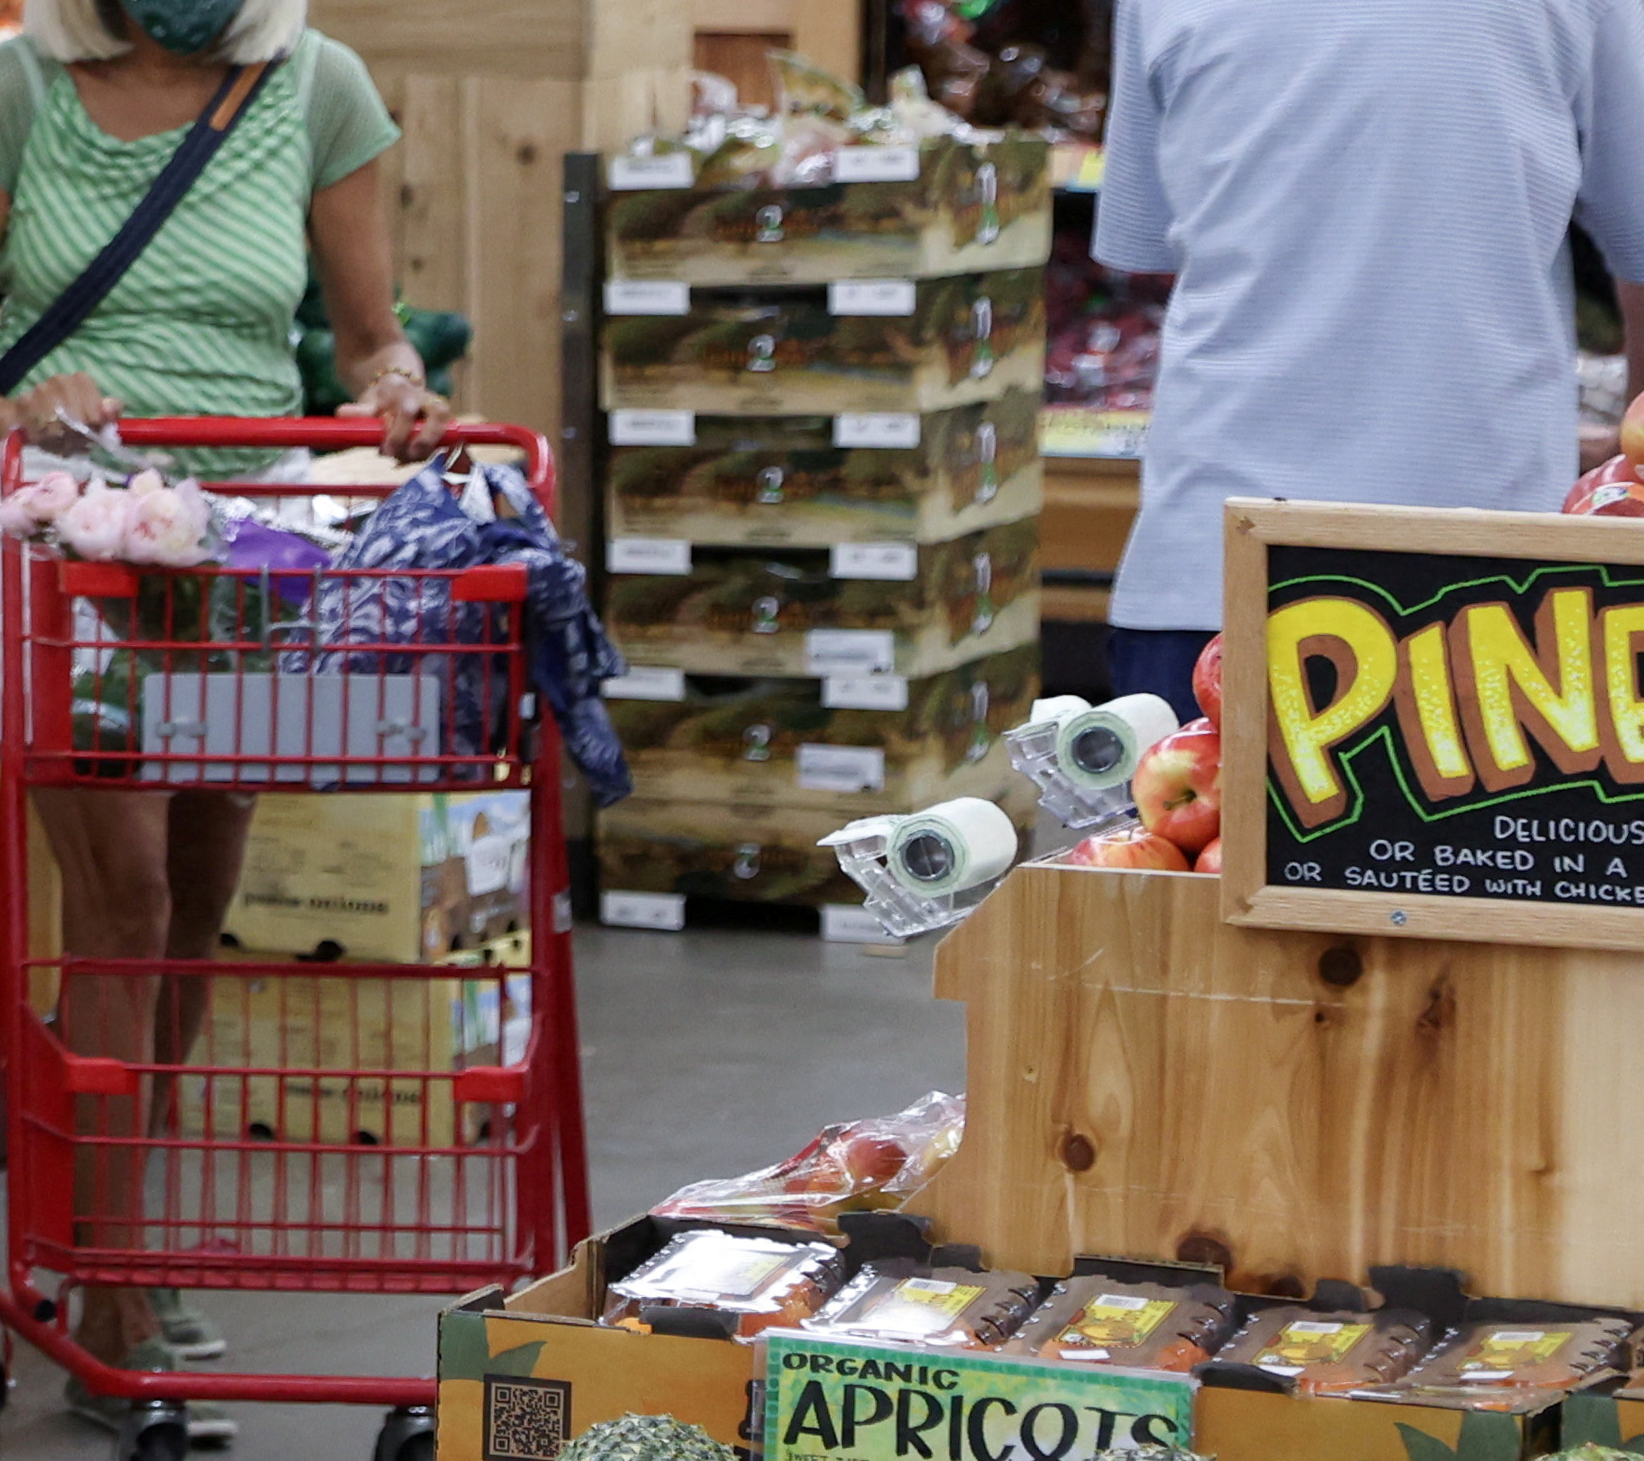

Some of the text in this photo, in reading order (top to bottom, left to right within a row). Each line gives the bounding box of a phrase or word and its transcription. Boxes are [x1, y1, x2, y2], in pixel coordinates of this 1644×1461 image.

[1494, 815, 1644, 844] DELICIOUS
[1370, 839, 1629, 878] OR BAKED IN A
[1284, 861, 1323, 882] OR
[1346, 867, 1471, 893] SAUTÉED
[782, 1351, 961, 1391] ORGANIC
